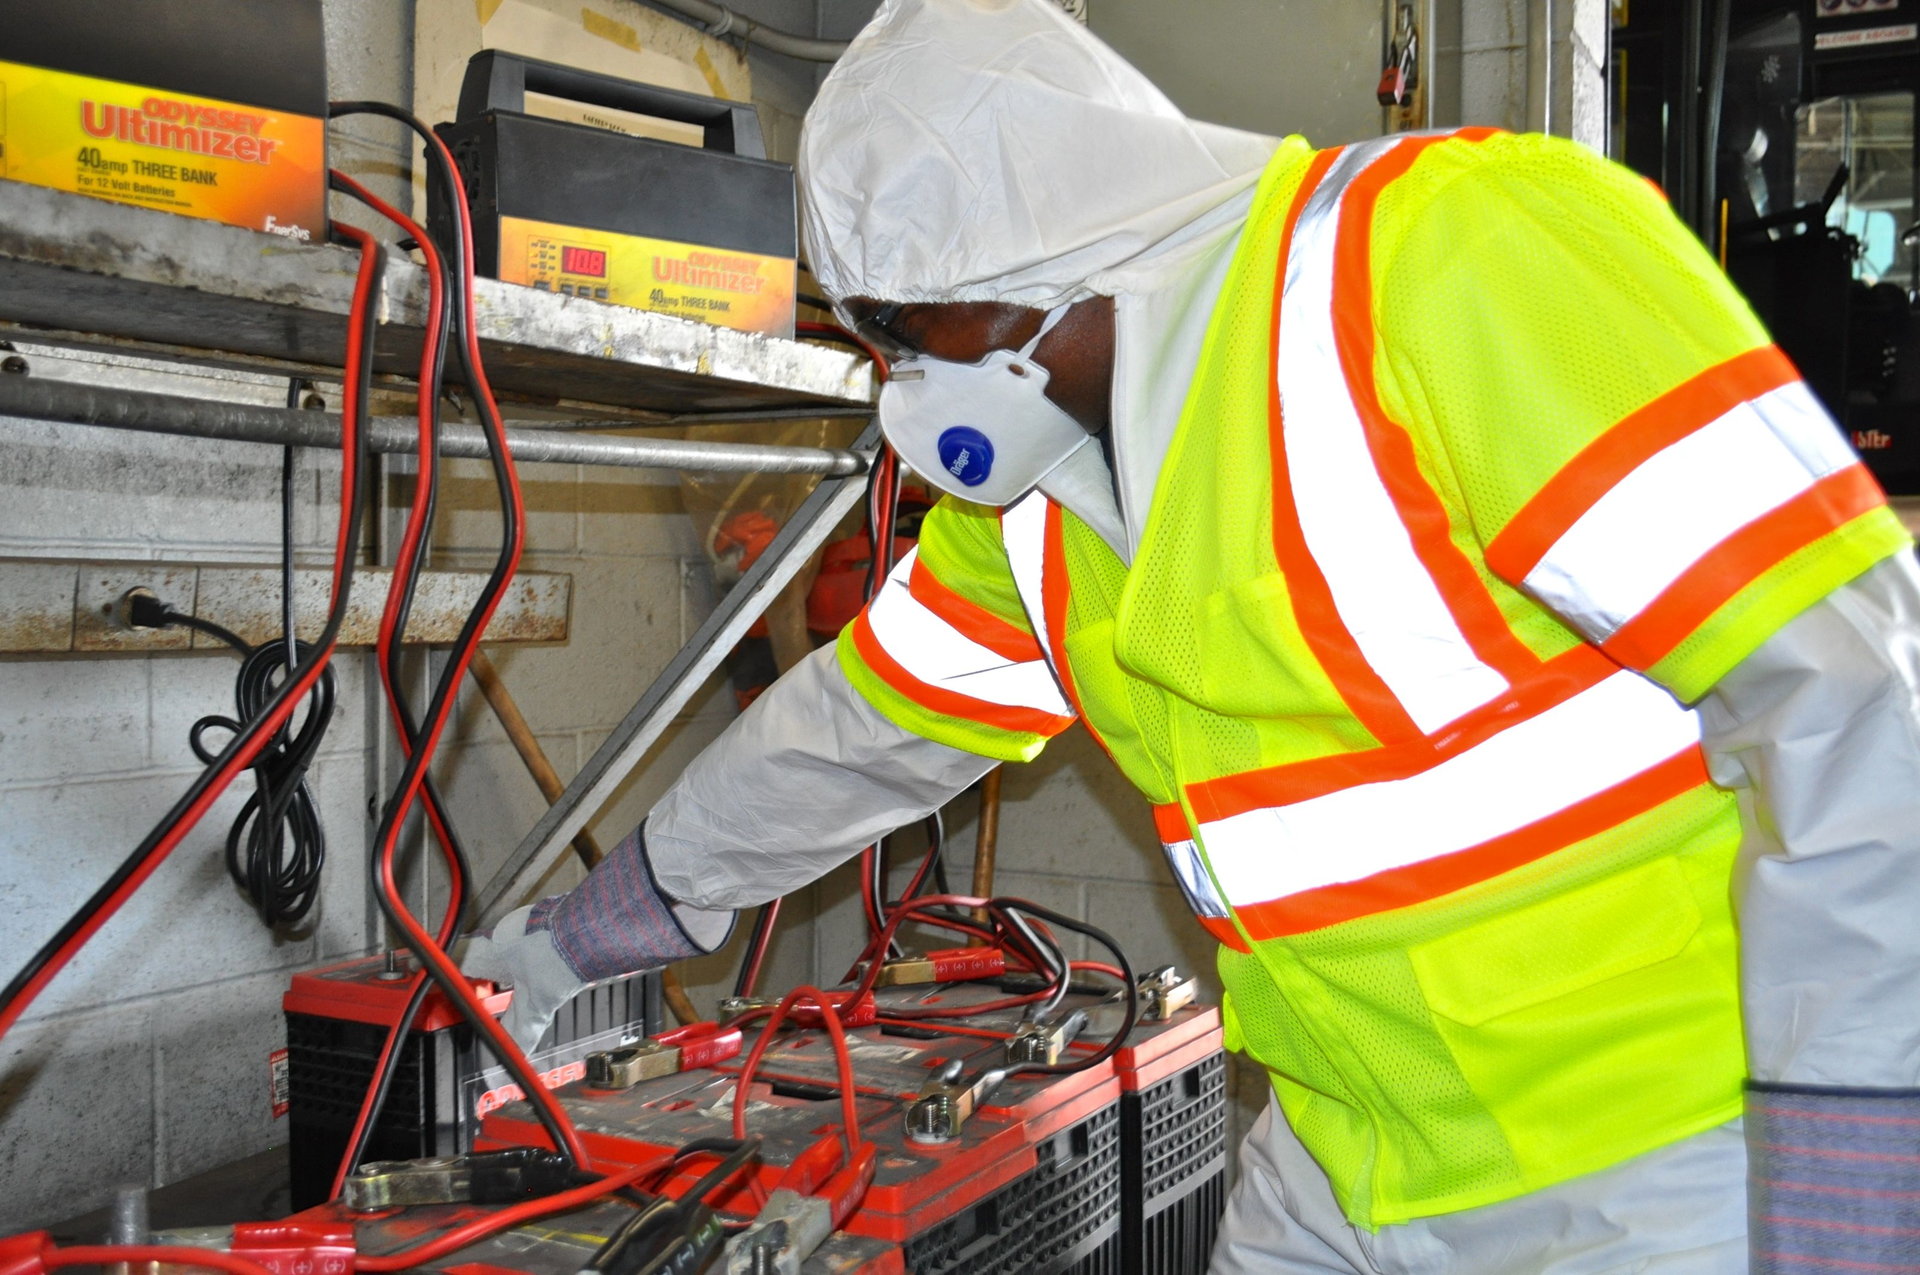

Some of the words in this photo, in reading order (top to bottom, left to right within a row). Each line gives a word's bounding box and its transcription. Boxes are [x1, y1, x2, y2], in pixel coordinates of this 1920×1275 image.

[142, 97, 269, 135] ODYSSEY
[82, 100, 276, 164] Ultimizer
[77, 174, 94, 186] For
[97, 177, 109, 188] 12
[112, 179, 131, 191] Volt
[133, 182, 176, 198] Batteries
[132, 159, 178, 180] THREE
[180, 167, 218, 187] BANK
[653, 256, 767, 294] Ultimizer
[681, 295, 708, 309] THREE
[708, 300, 731, 312] BANK
[950, 447, 970, 476] Dräger
